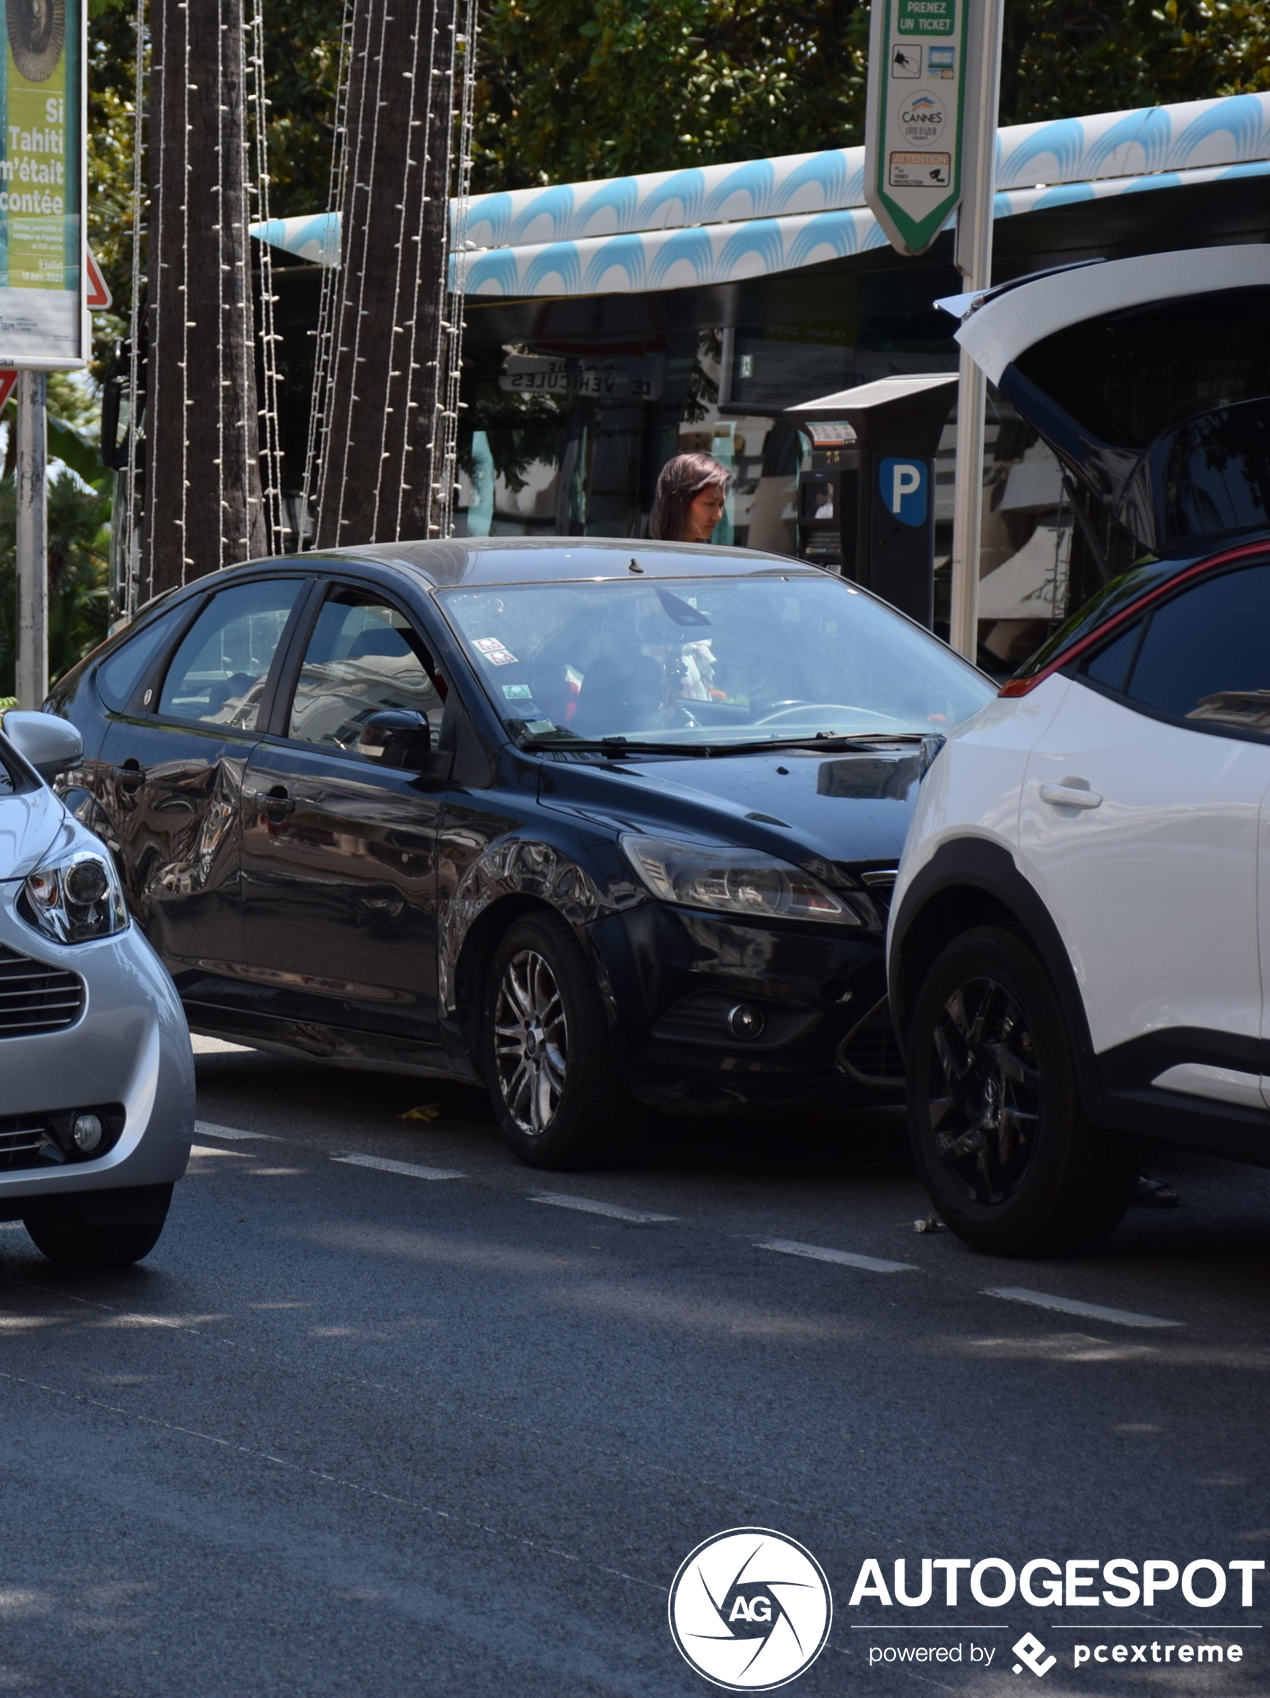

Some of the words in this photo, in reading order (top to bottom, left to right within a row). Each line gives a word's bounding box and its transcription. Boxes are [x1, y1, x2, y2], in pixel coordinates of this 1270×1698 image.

[907, 2, 946, 13] PRENEZ
[900, 18, 914, 29] UN
[919, 18, 951, 30] TICKET
[45, 97, 64, 123] Si
[902, 111, 942, 123] CANNES
[8, 125, 64, 154] Tahiti
[893, 154, 947, 164] ATTENTION
[44, 260, 63, 270] juillet
[30, 273, 45, 281] nov.
[46, 273, 63, 282] 2022
[893, 464, 921, 513] P
